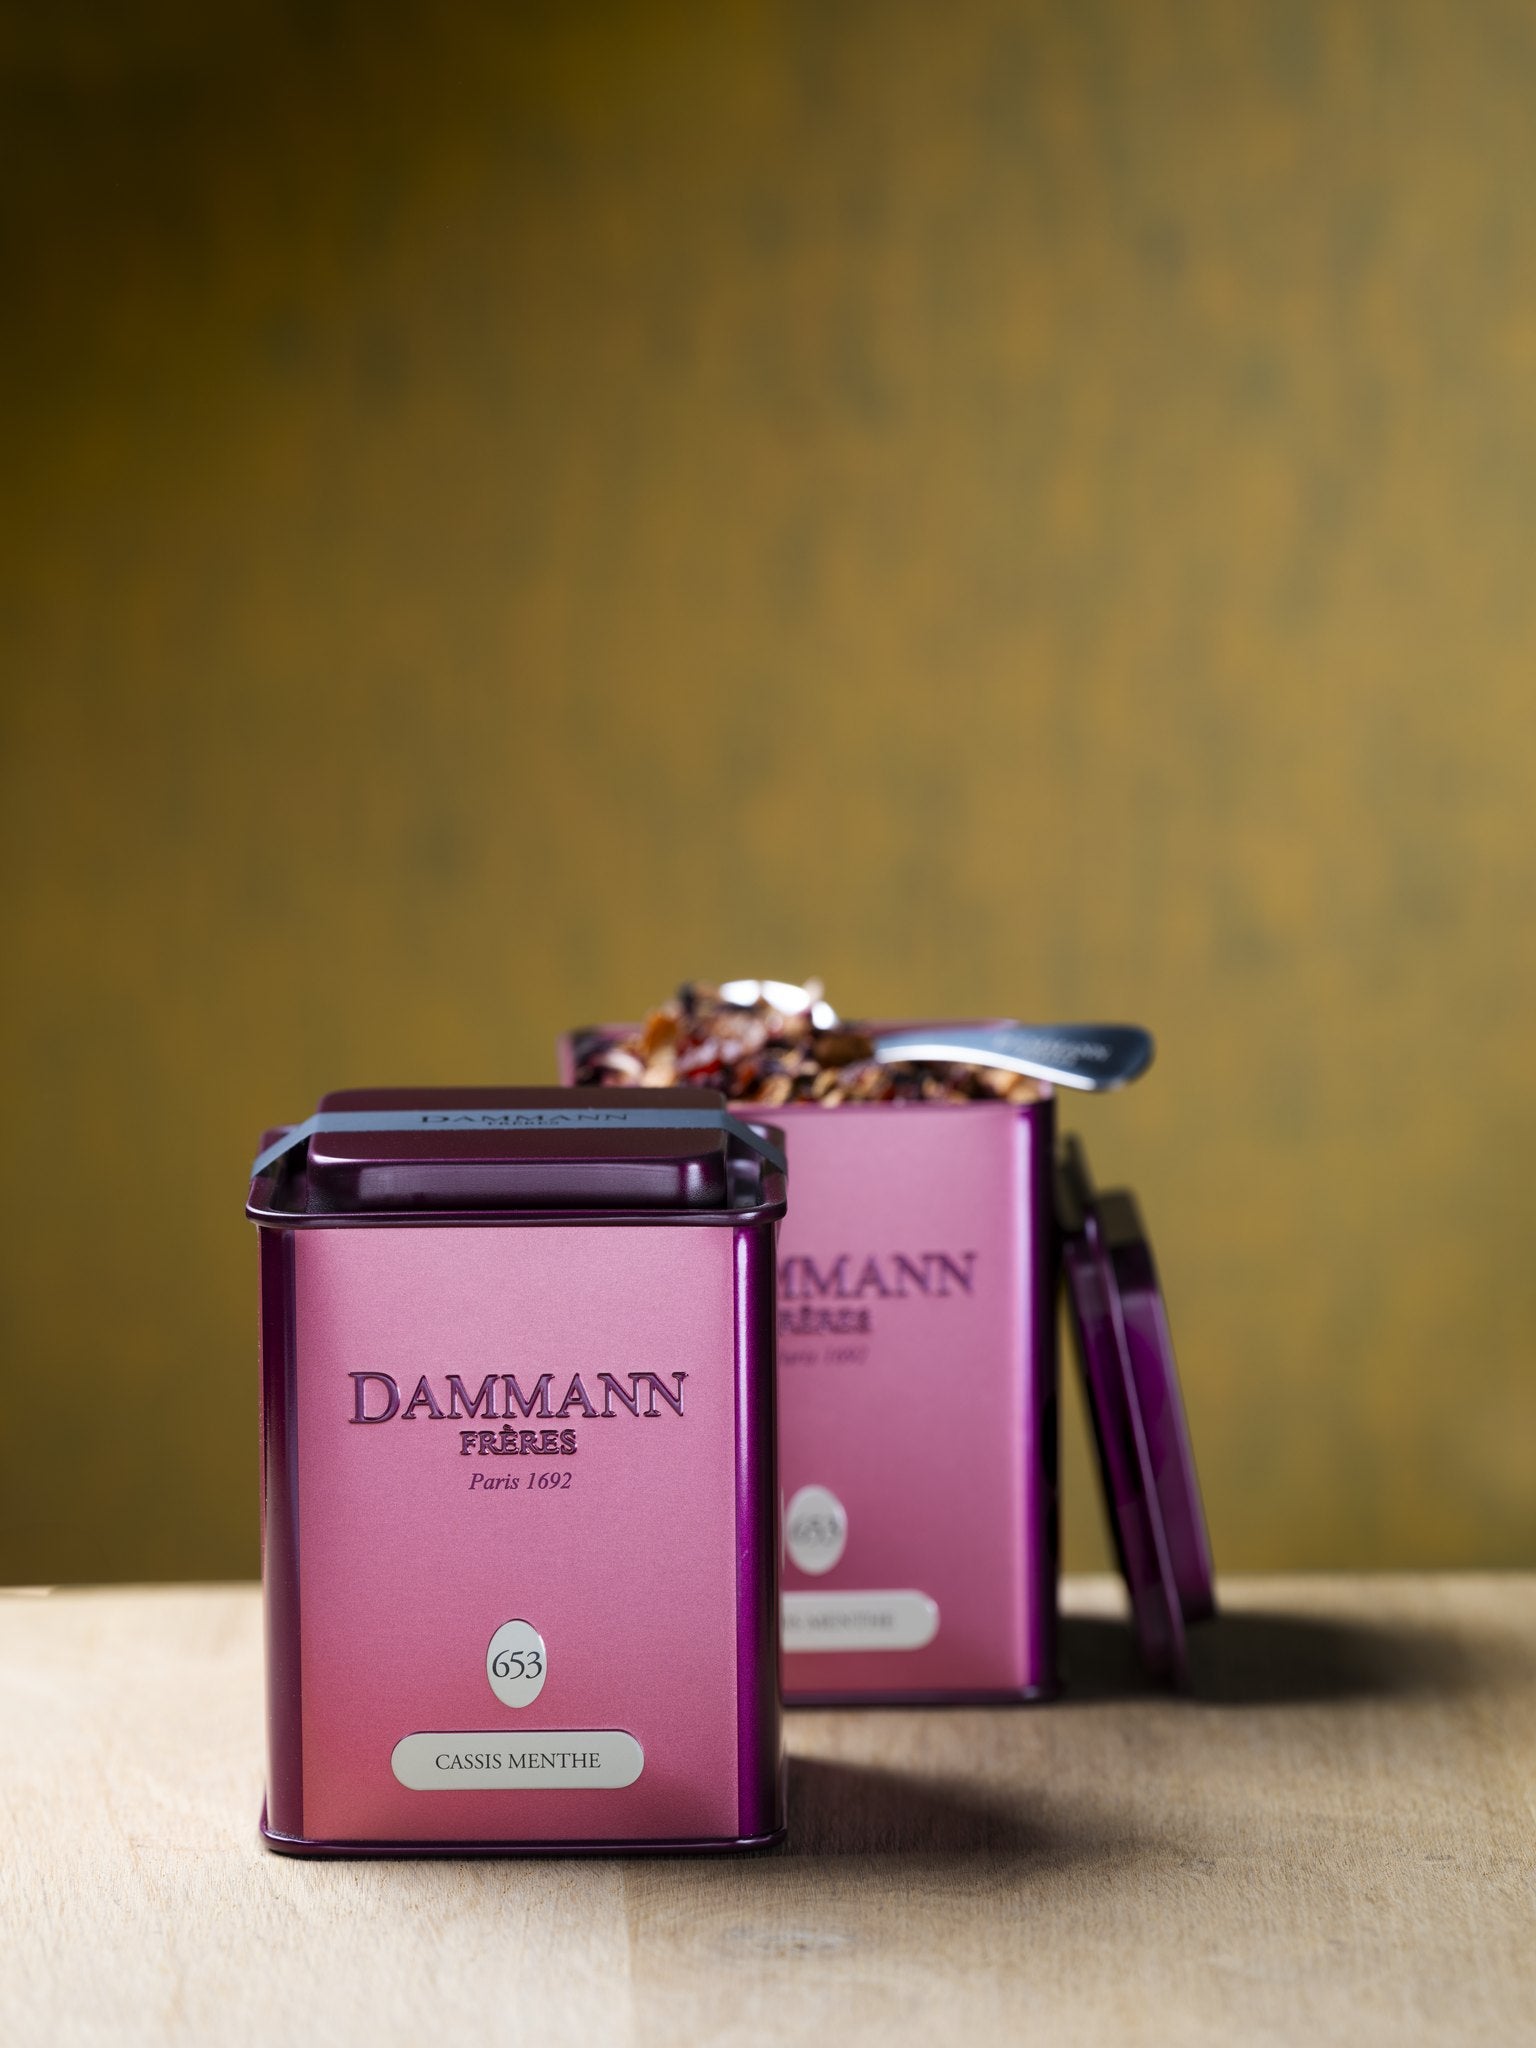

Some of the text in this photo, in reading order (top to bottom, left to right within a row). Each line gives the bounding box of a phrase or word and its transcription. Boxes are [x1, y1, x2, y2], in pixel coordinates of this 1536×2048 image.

[421, 1114, 628, 1124] DAMMANN
[348, 1371, 688, 1424] DAMMANN
[459, 1424, 578, 1455] FRÈRES
[468, 1472, 572, 1490] Paris 1692
[492, 1650, 543, 1679] 653
[435, 1752, 602, 1770] CASSIS MENTHE
